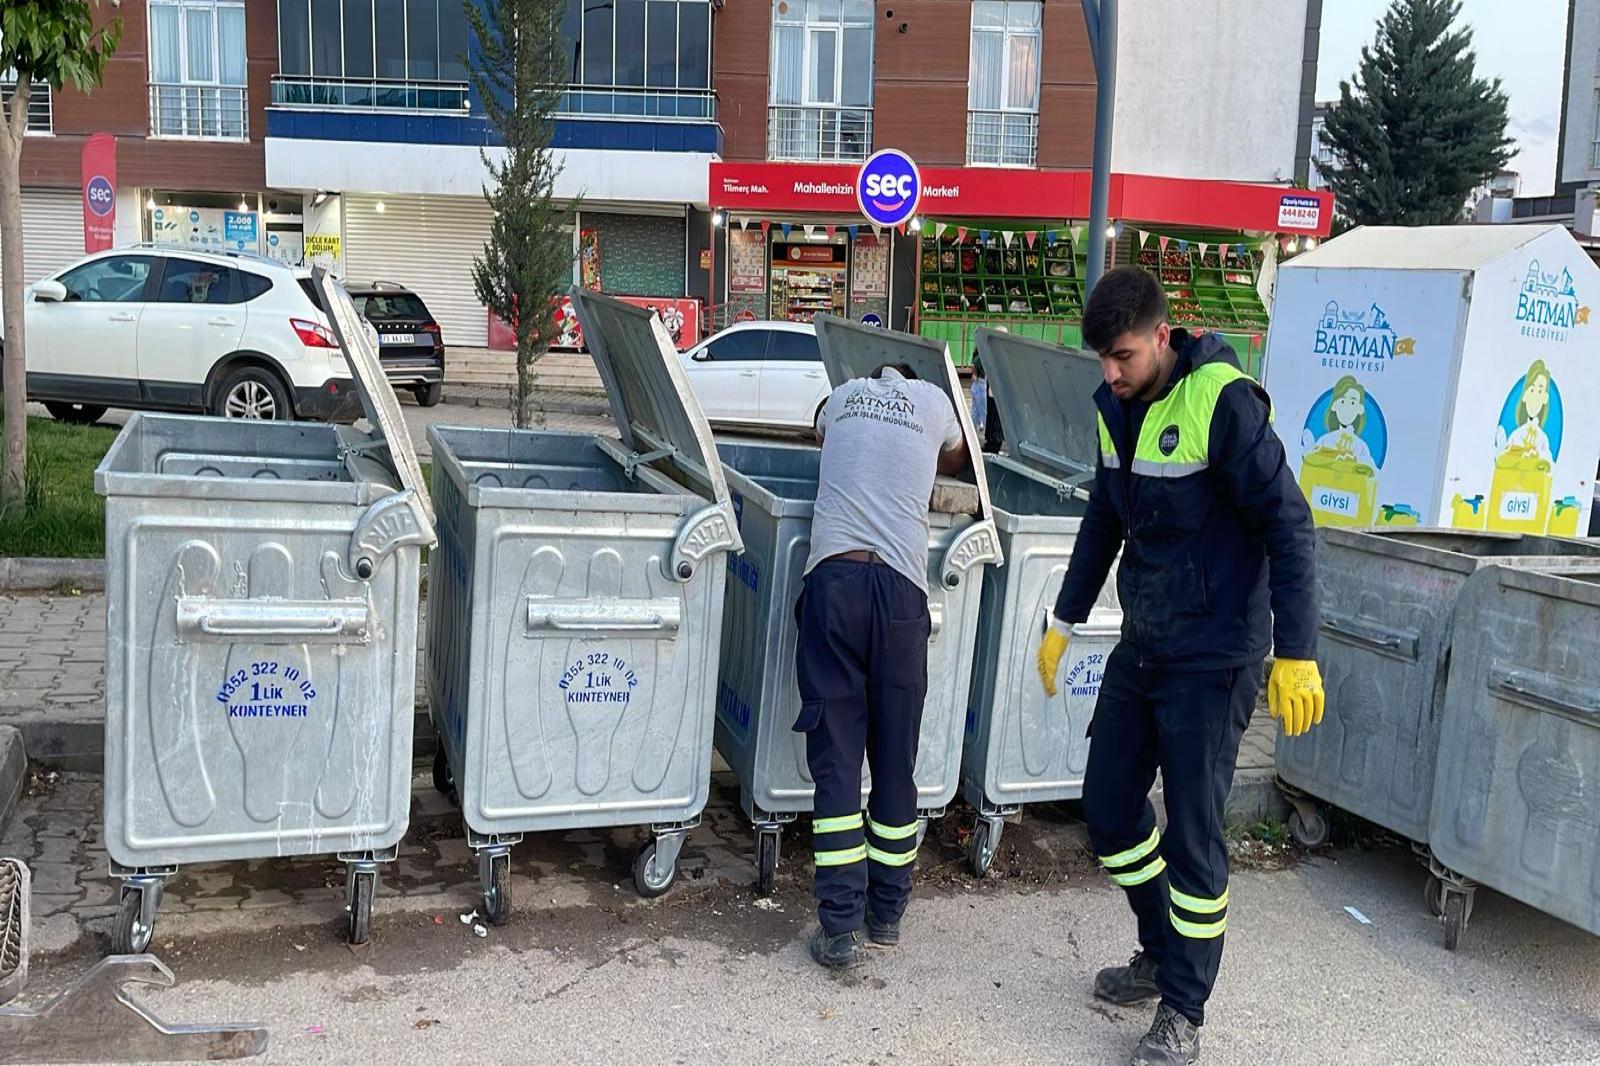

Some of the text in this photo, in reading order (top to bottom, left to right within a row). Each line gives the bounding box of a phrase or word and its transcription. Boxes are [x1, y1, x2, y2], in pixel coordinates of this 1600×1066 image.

[750, 185, 769, 193] Mah.
[794, 173, 959, 200] Mahallenizin seç Marketi
[228, 216, 252, 225] 2.000
[1516, 294, 1578, 328] BATMAN
[1521, 326, 1568, 342] BELEDİYESİ
[1313, 330, 1397, 360] BATMAN
[1321, 358, 1384, 372] BELEDİYESİ
[844, 396, 915, 416] BATMAN
[1320, 493, 1350, 510] GİYSİ
[1507, 496, 1530, 513] GİYSİ
[1087, 654, 1103, 665] 322
[559, 653, 638, 689] 0352 322 10 02
[216, 661, 316, 703] 0352 322 10 02
[568, 692, 630, 703] KONTEYNER
[229, 705, 307, 717] KONTEYNER
